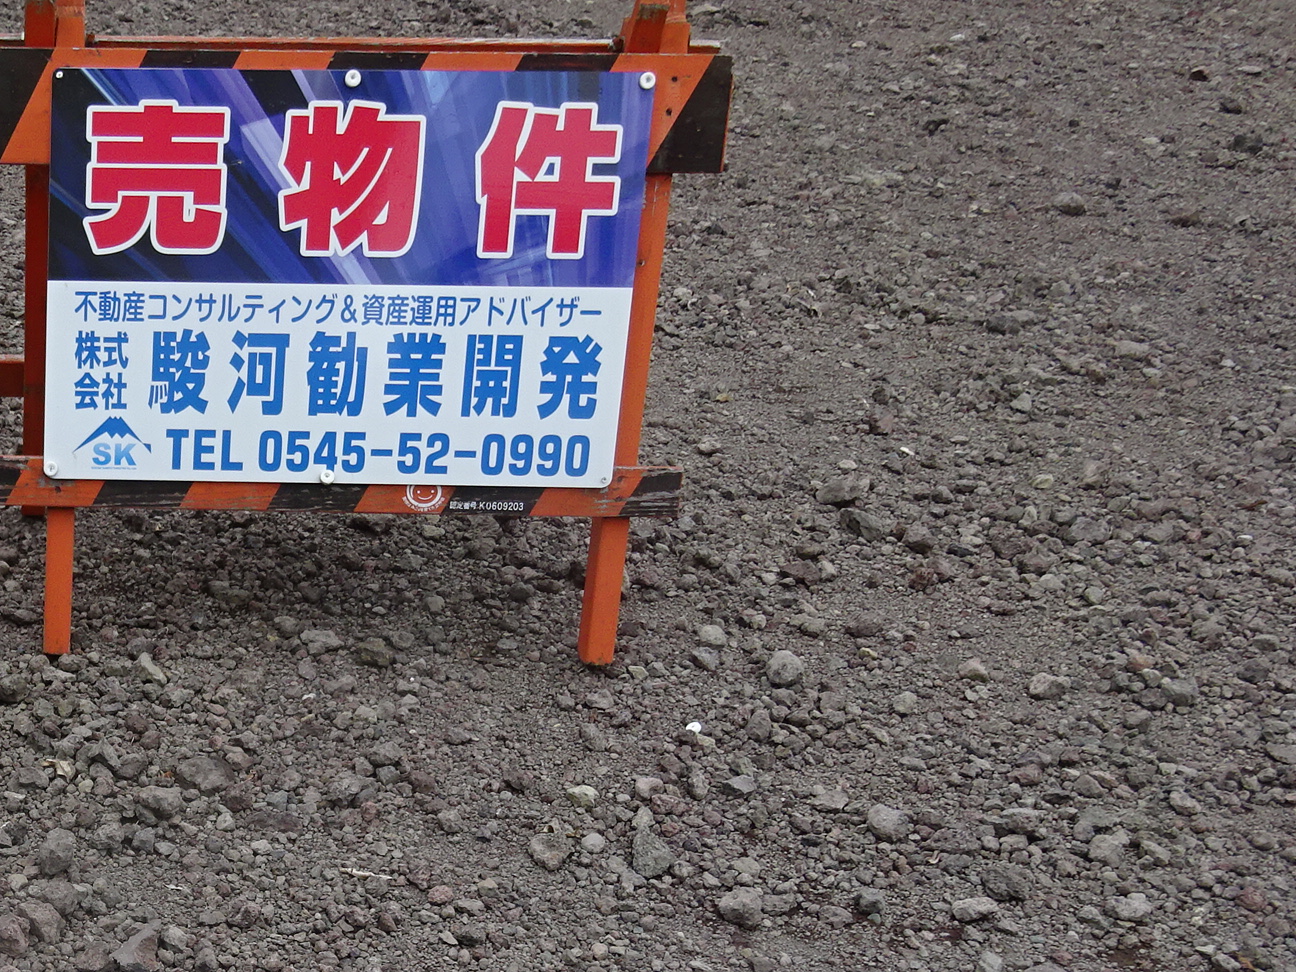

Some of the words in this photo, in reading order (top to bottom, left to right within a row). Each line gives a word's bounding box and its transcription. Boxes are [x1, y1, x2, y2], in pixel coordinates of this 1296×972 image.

[84, 99, 623, 260] 売物件
[74, 290, 603, 327] 不動産コンサルティング&資産運用アドバイザー
[74, 330, 129, 369] 株式
[73, 372, 128, 411] 会社
[148, 328, 603, 420] 駿河勧業開発
[92, 442, 137, 466] SK
[165, 428, 244, 471] TEL
[258, 429, 591, 477] 0545-52-0990
